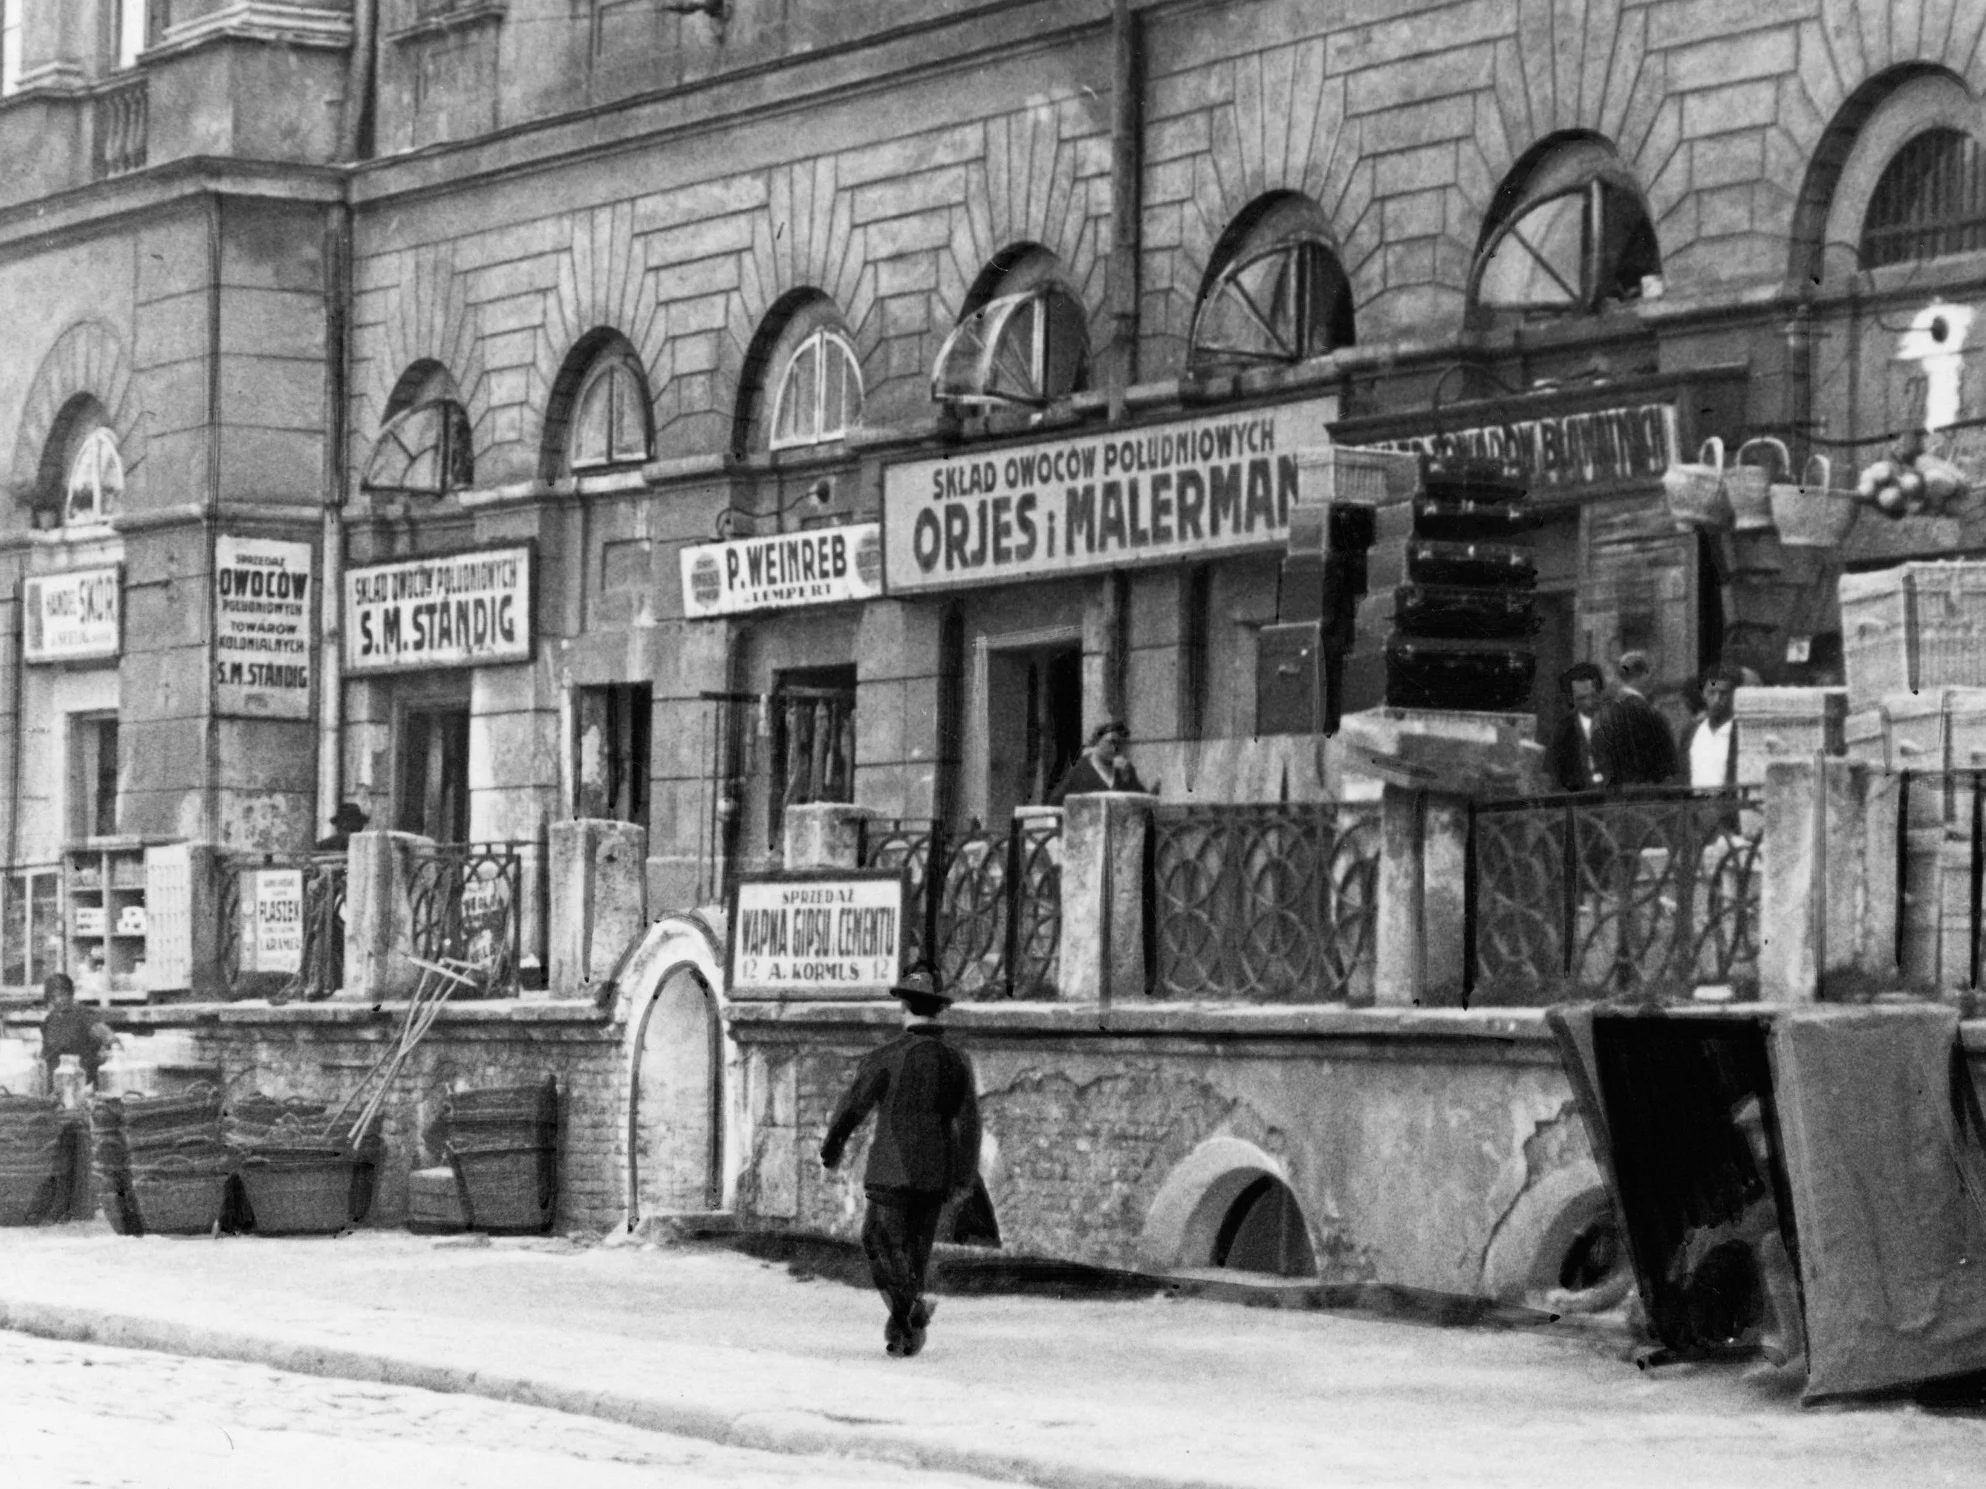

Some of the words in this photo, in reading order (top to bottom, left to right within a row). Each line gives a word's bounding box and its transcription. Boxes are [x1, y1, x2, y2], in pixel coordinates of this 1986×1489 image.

[933, 461, 997, 501] SKŁAD
[1005, 444, 1096, 489] OWOCÓW
[914, 493, 1037, 574] ORJES
[1066, 453, 1299, 557] MALERMAN
[219, 566, 308, 601] OWOCÓW
[726, 547, 746, 592] P.
[746, 534, 848, 588] WEINREB
[743, 908, 787, 957] WAPNA
[792, 907, 831, 958] GIPSU
[838, 907, 895, 957] CEMENTU
[743, 959, 757, 980] 12
[768, 962, 787, 981] A.
[872, 958, 889, 980] 12
